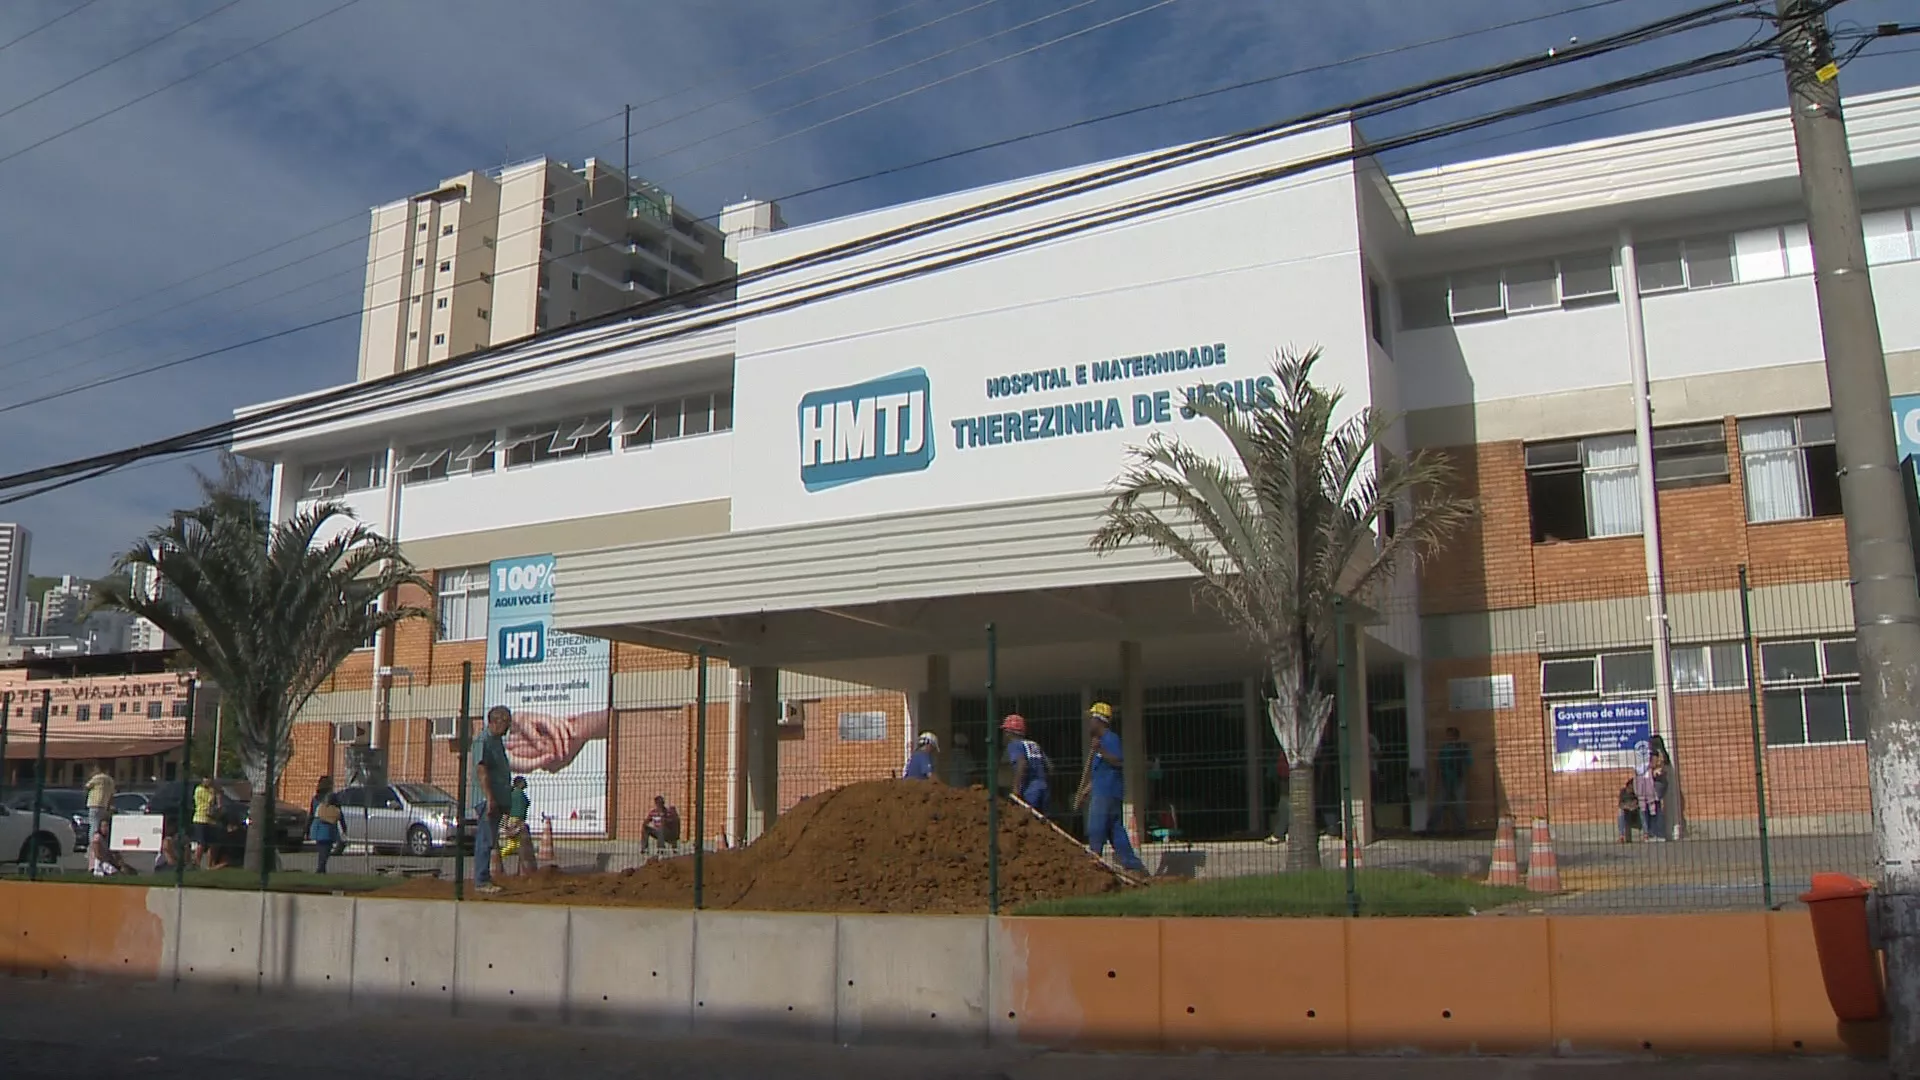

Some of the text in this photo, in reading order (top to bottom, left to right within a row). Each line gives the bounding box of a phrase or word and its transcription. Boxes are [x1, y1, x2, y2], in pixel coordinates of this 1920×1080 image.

[986, 342, 1226, 399] HOSPITAL E MATERNIDADE
[950, 375, 1276, 450] THEREZINHA DE JESUS
[802, 389, 925, 467] HMTJ
[494, 596, 518, 608] AQUI
[505, 631, 538, 660] HTJ
[546, 634, 601, 647] THEREZINHA
[546, 645, 587, 658] DE JESUS
[1557, 706, 1646, 721] Governo de Minas
